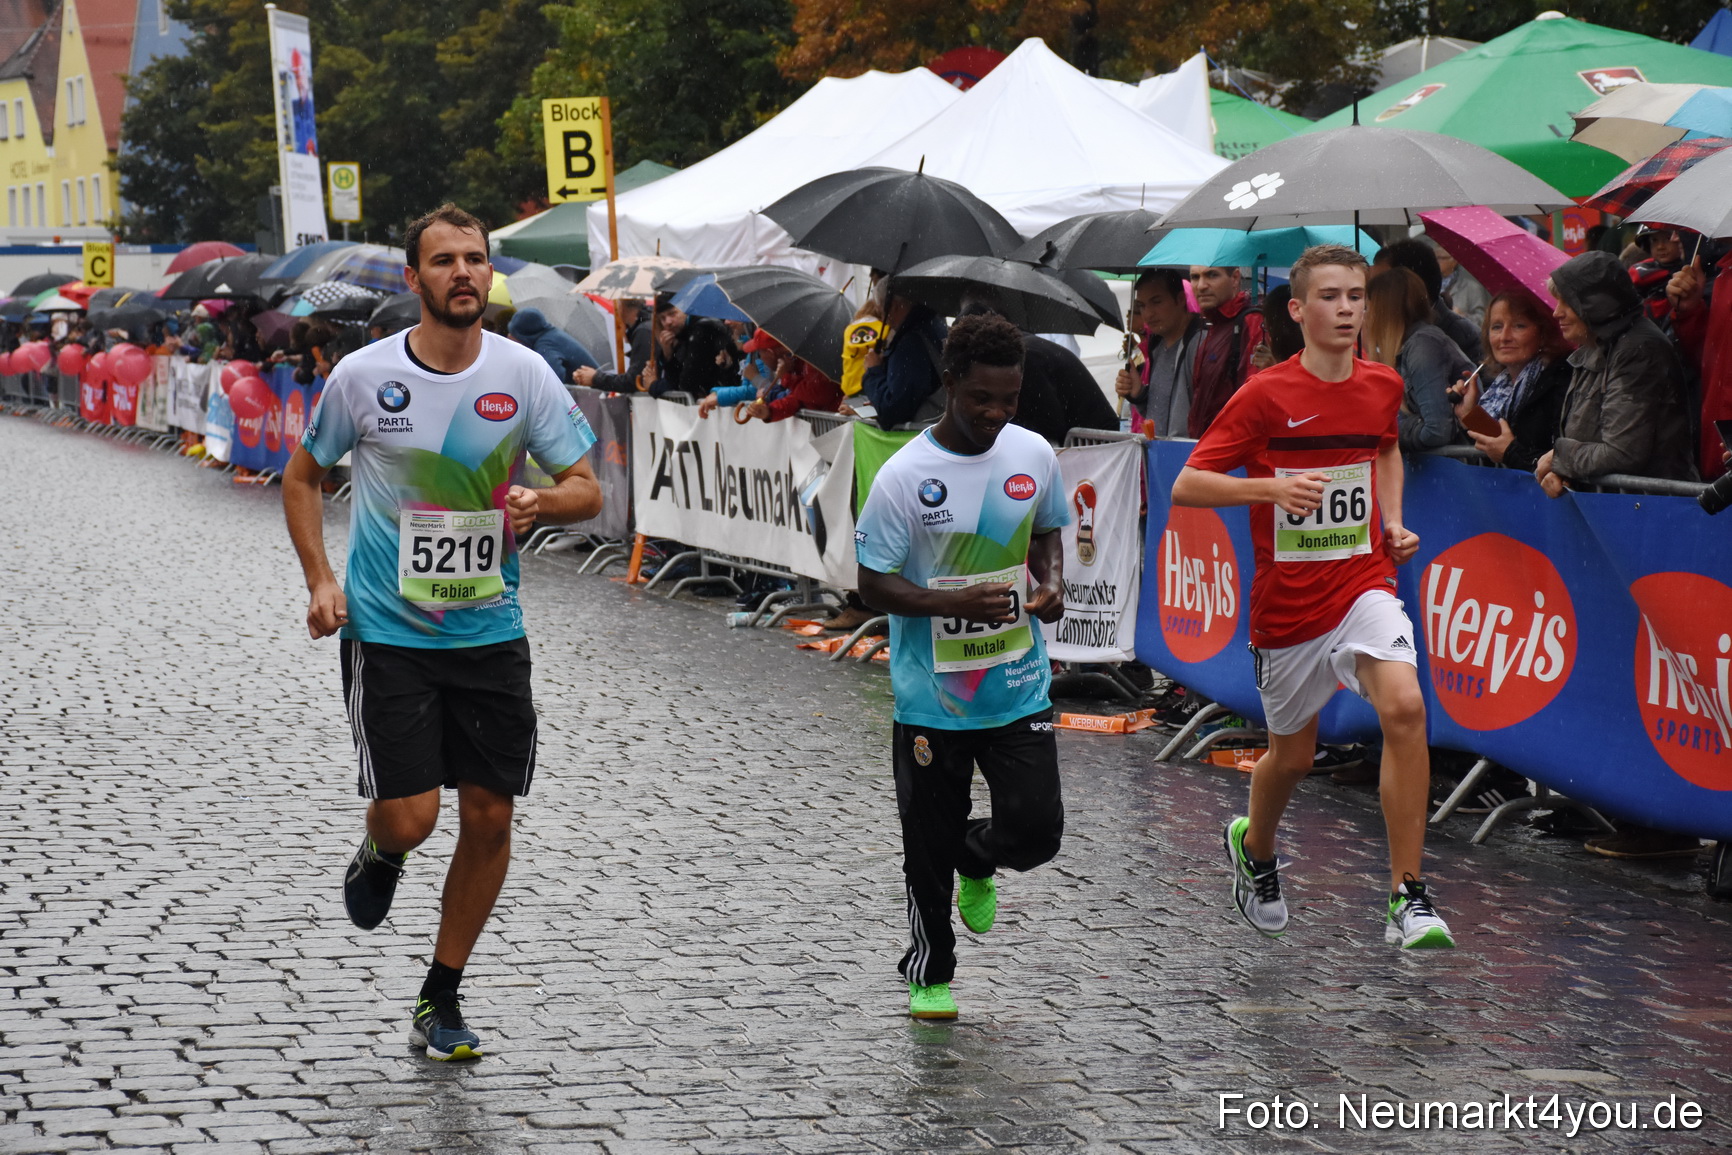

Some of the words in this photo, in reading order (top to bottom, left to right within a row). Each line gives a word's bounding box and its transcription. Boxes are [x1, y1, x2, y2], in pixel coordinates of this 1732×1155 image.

[551, 103, 602, 121] Block
[563, 130, 595, 179] B
[85, 242, 111, 252] Block
[90, 255, 106, 278] C
[380, 381, 407, 393] BMW
[481, 399, 513, 414] Hervis
[377, 417, 413, 426] PARTL
[1009, 481, 1034, 493] Hervis
[1286, 486, 1366, 526] 166
[452, 514, 496, 527] BOCK
[921, 509, 953, 521] PARTL
[923, 517, 954, 527] Neumarkt
[410, 521, 445, 529] NeuerMarkt
[1297, 533, 1356, 549] Jonathan
[412, 535, 494, 573] 5219
[1164, 529, 1235, 633] Hervis
[432, 584, 476, 598] Fabian
[1056, 611, 1116, 648] Lammsbrä
[1165, 615, 1202, 638] SPORTS
[1426, 563, 1567, 694] Hervis
[963, 639, 1006, 657] Mutala
[1434, 667, 1485, 699] SPORTS
[1069, 716, 1108, 729] WERBUNG
[1656, 718, 1721, 755] SPORTS
